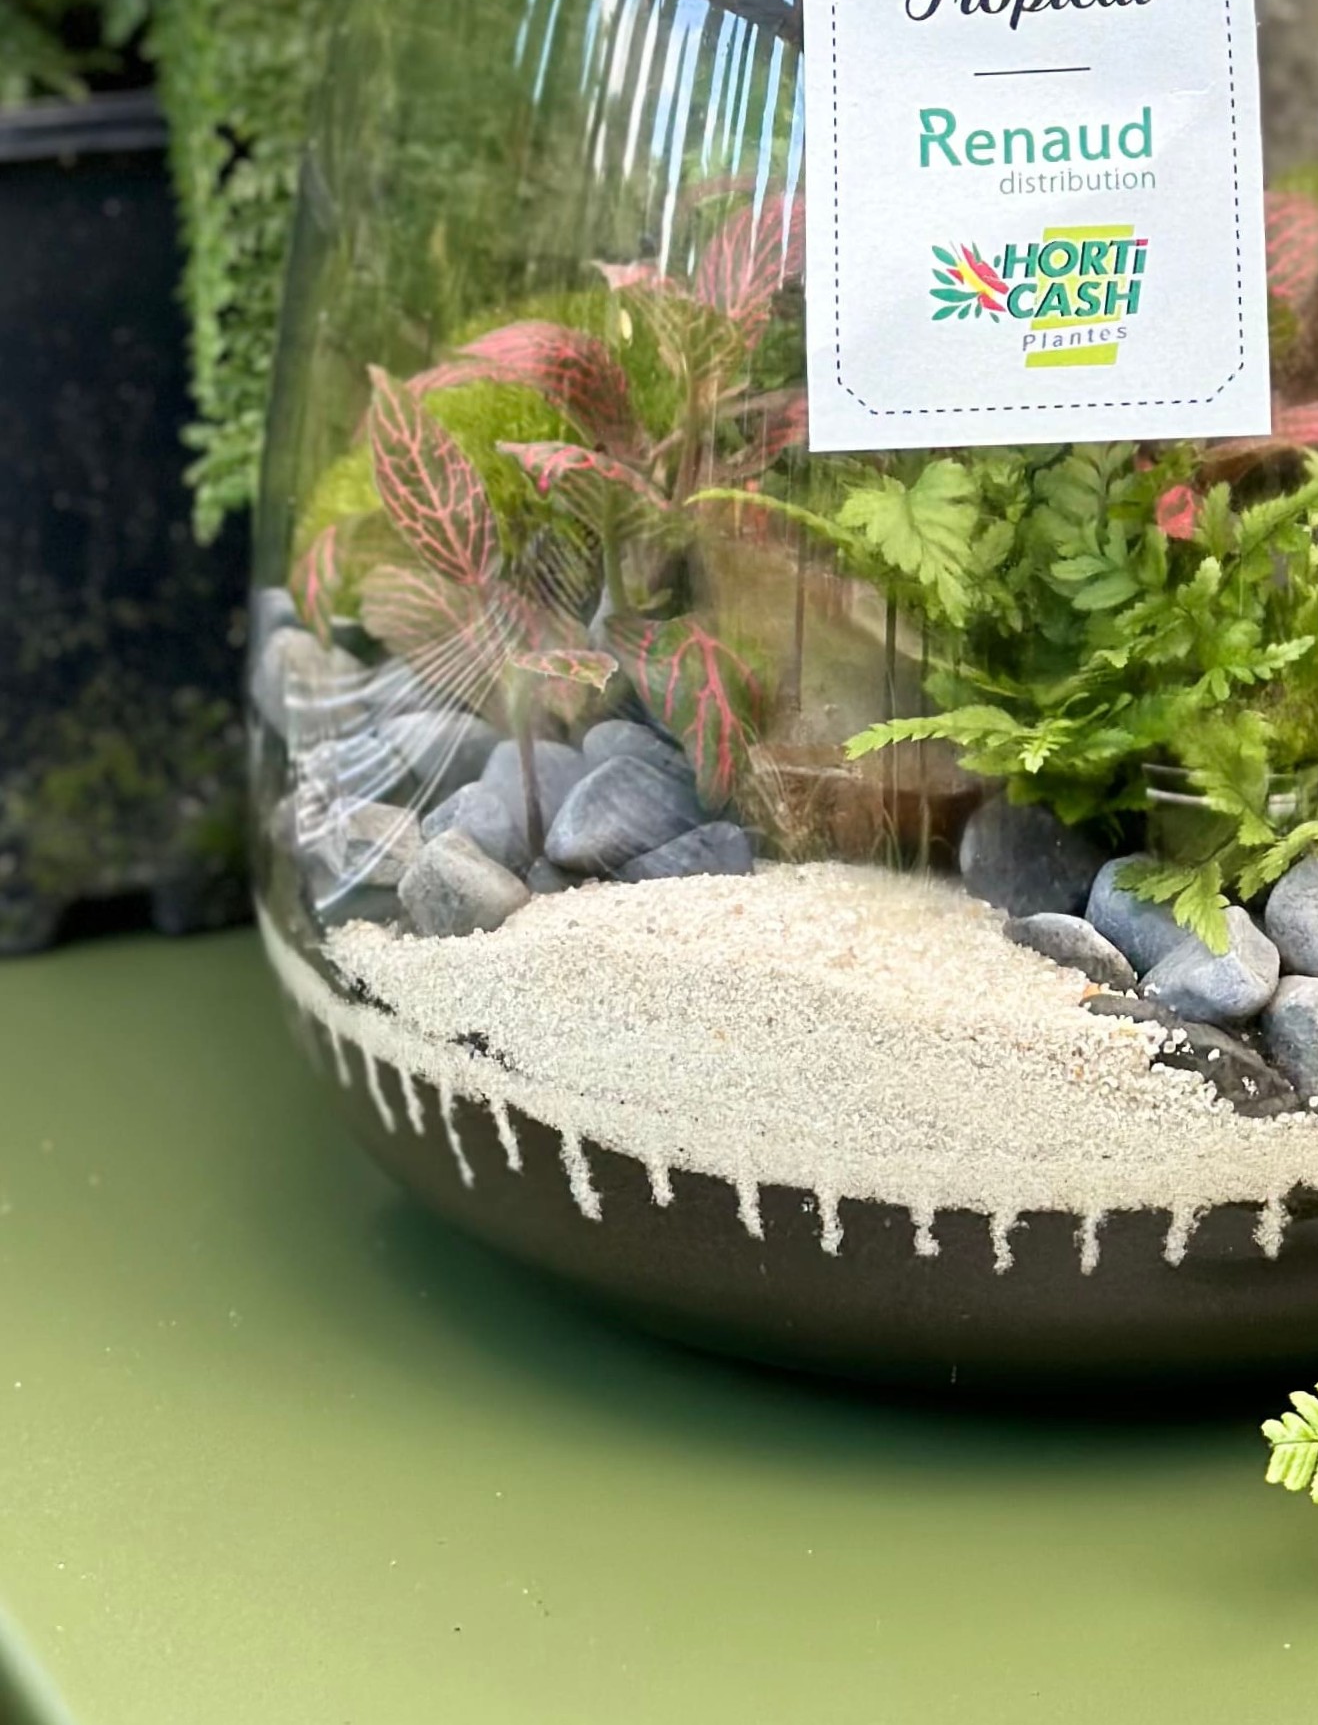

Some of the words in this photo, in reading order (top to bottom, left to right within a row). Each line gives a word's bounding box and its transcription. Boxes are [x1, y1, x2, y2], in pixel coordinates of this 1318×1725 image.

[919, 106, 1153, 168] Renaud
[999, 168, 1156, 195] distribution
[1006, 279, 1141, 319] CASH
[1022, 326, 1127, 352] Plantes
